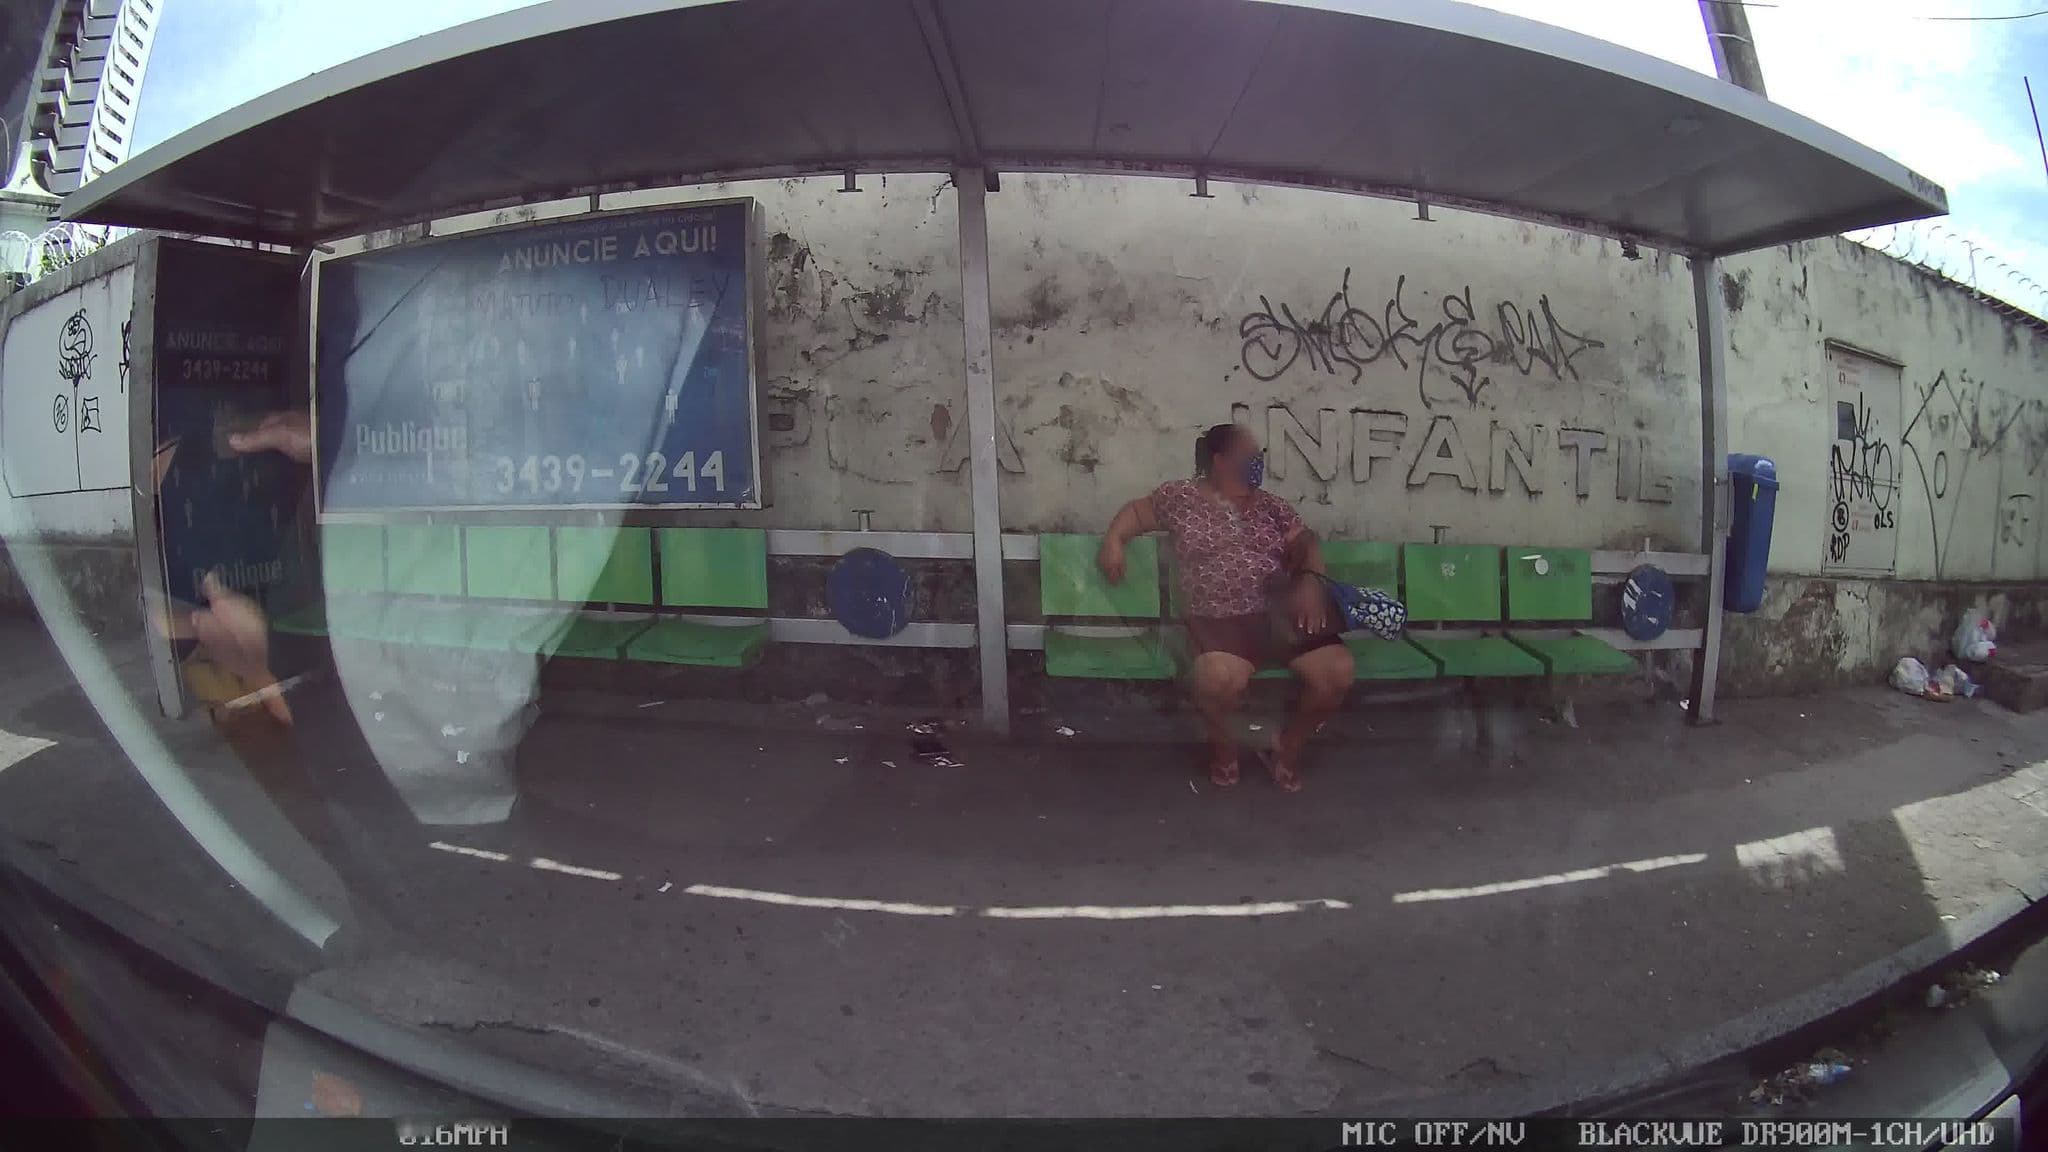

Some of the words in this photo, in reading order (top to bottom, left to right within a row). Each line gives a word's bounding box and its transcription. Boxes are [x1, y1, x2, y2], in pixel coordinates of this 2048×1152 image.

[500, 235, 618, 272] ANUNCIE
[632, 224, 717, 259] AQUI!
[182, 358, 269, 381] 3439-2244
[496, 450, 724, 495] 3439-2244
